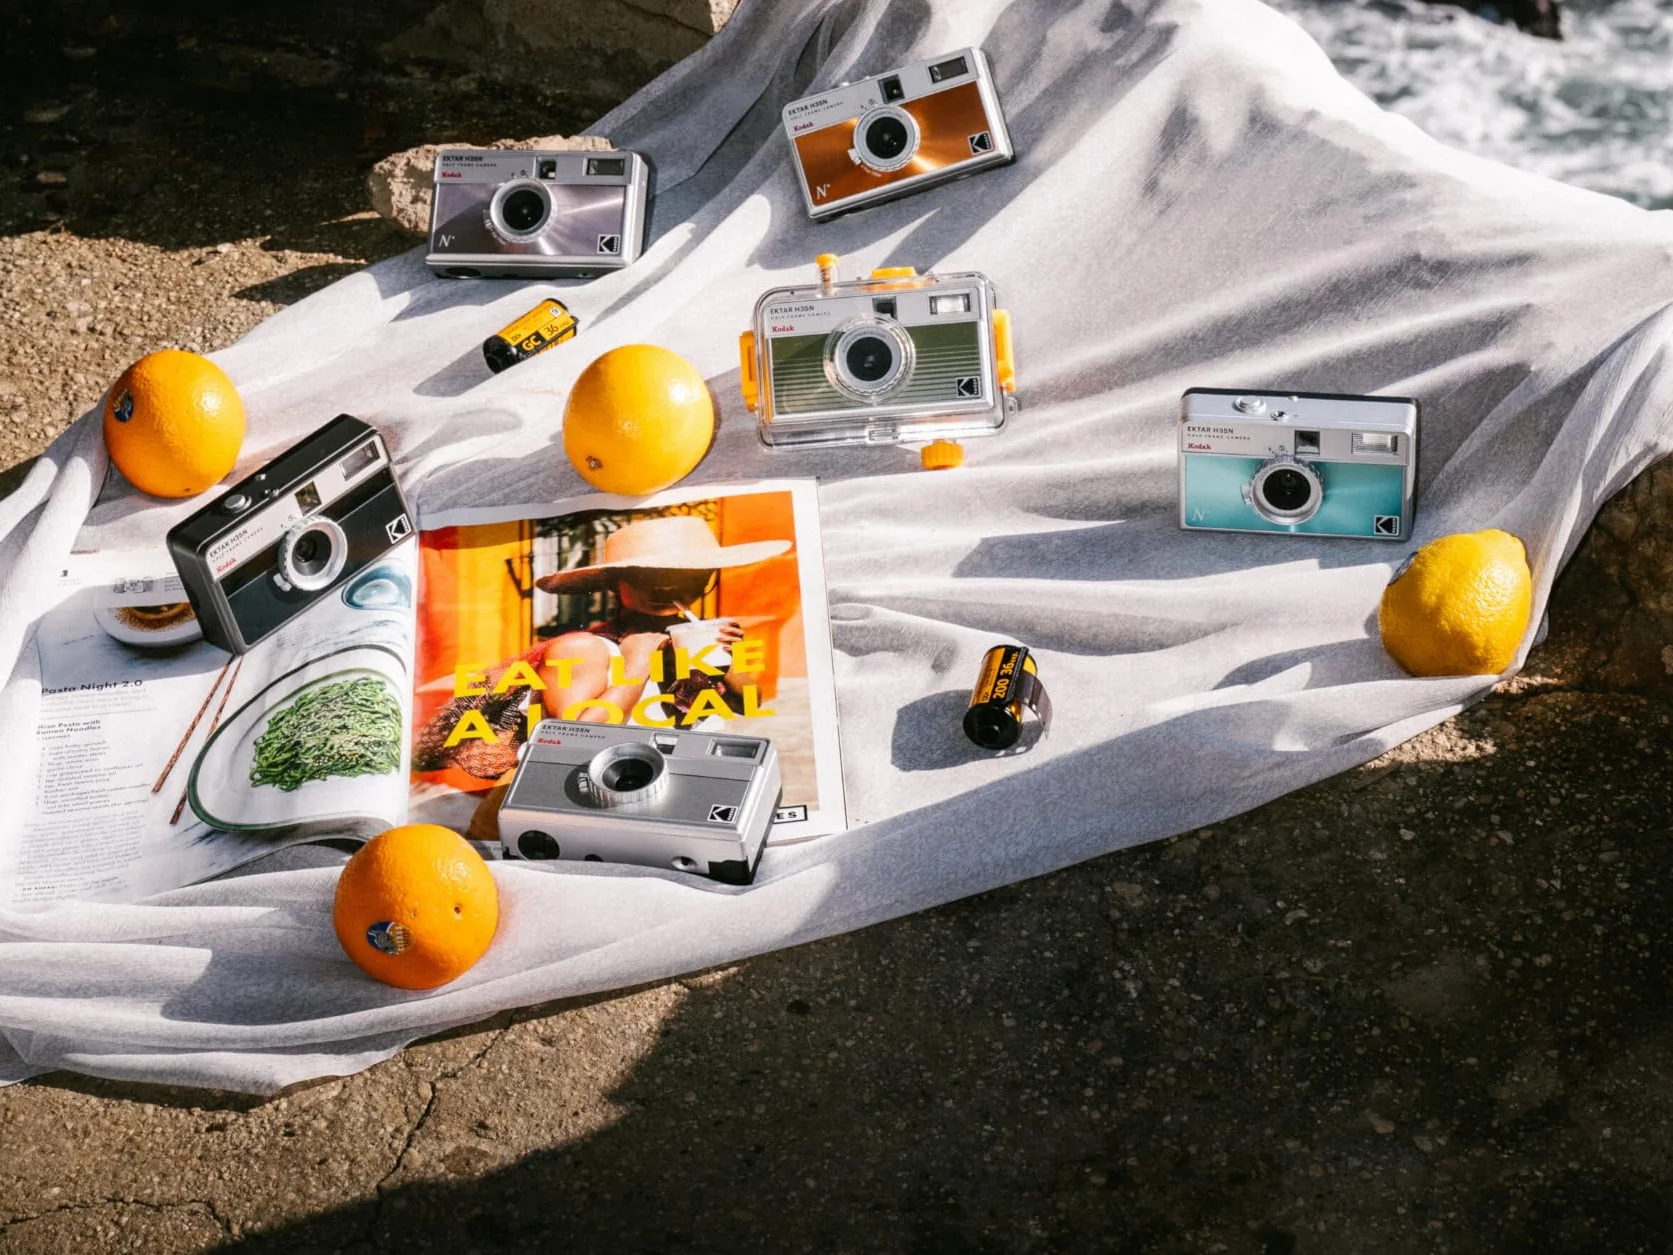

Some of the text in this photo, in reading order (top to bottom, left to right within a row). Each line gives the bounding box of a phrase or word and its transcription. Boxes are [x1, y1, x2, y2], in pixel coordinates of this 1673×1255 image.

[788, 99, 828, 116] EKTAR H35N
[793, 122, 814, 132] Kodak
[770, 307, 793, 315] EKTAR
[772, 325, 795, 333] Kodak
[522, 335, 541, 351] GC
[544, 324, 559, 336] 36
[1188, 442, 1211, 450] Kodak
[209, 529, 248, 558] EKTAR H35N
[216, 557, 237, 573] Kodak
[454, 640, 766, 698] EAT LIKE
[41, 679, 143, 695] Pasta Night 2.0
[992, 678, 1009, 700] 200
[445, 709, 501, 747] A
[537, 737, 561, 745] Kodak
